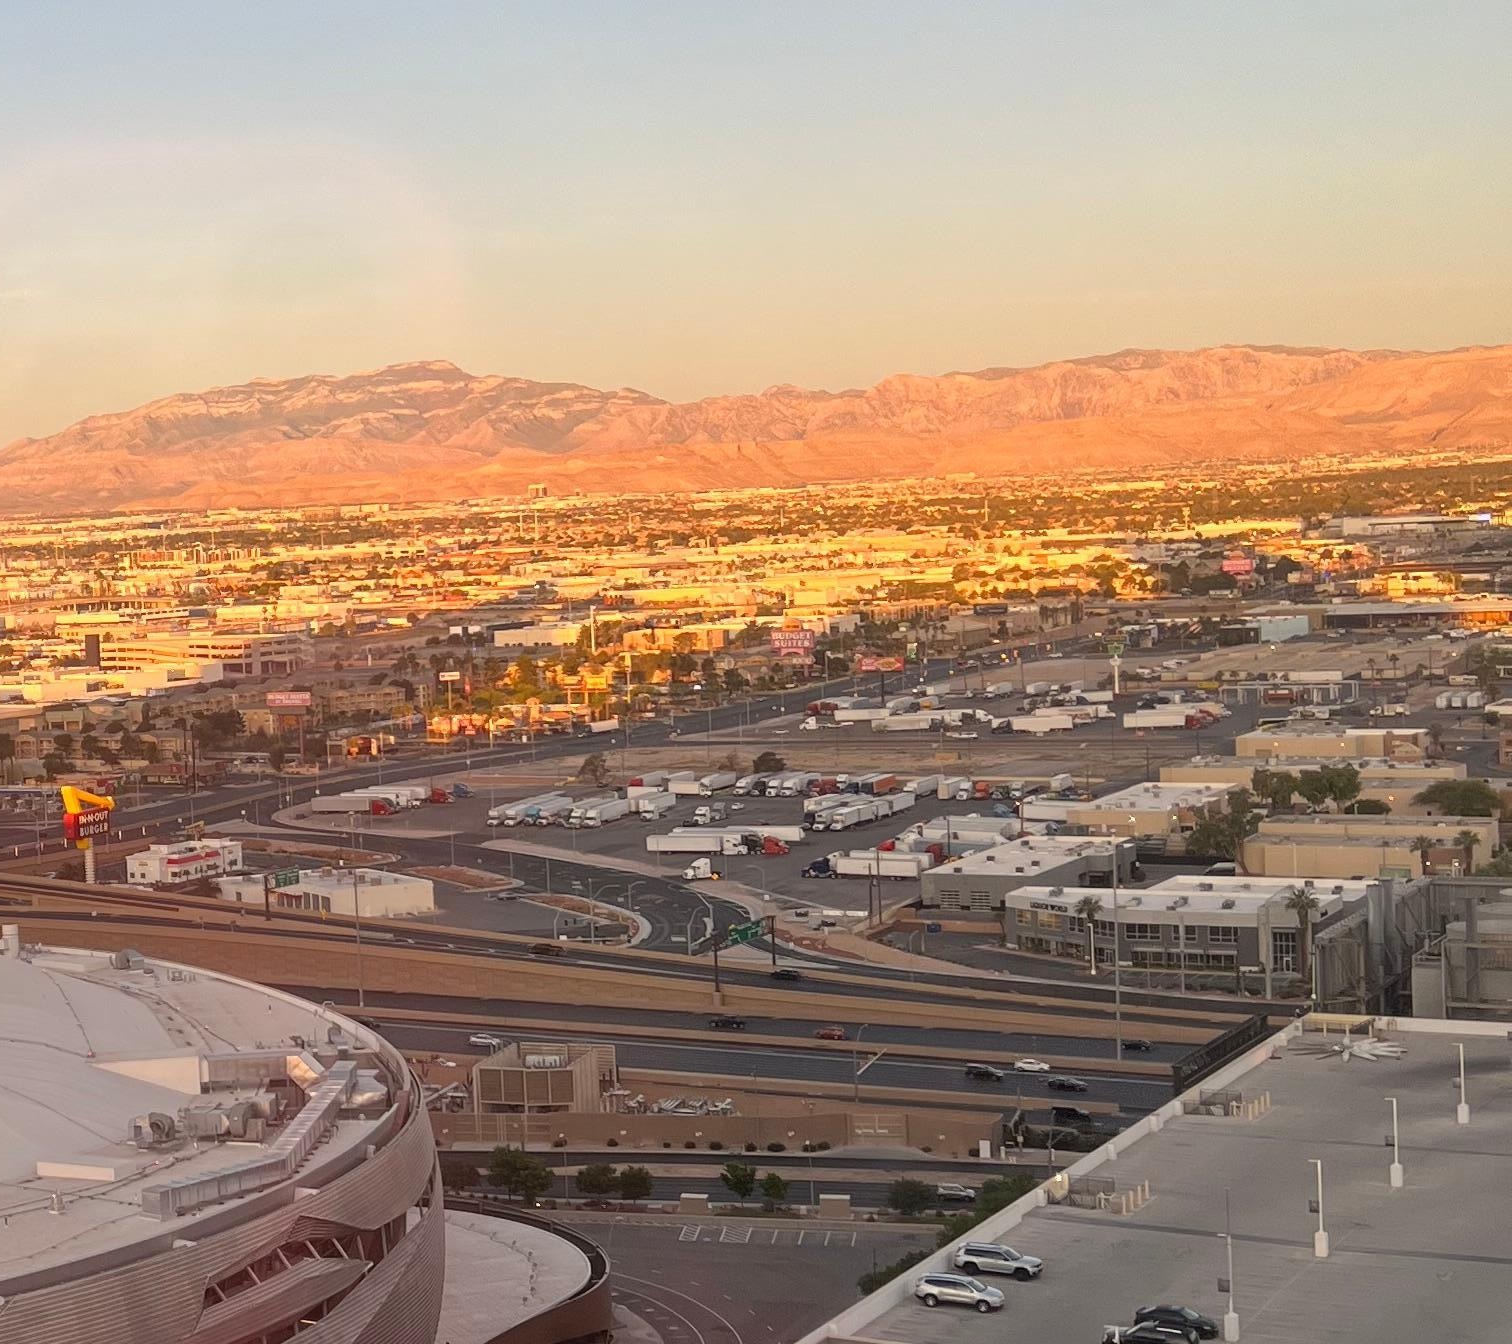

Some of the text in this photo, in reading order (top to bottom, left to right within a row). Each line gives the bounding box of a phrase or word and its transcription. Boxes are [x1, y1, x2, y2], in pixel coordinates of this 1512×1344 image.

[772, 631, 811, 640] BUDGET
[774, 639, 810, 648] SUITES
[79, 822, 108, 836] BURGER
